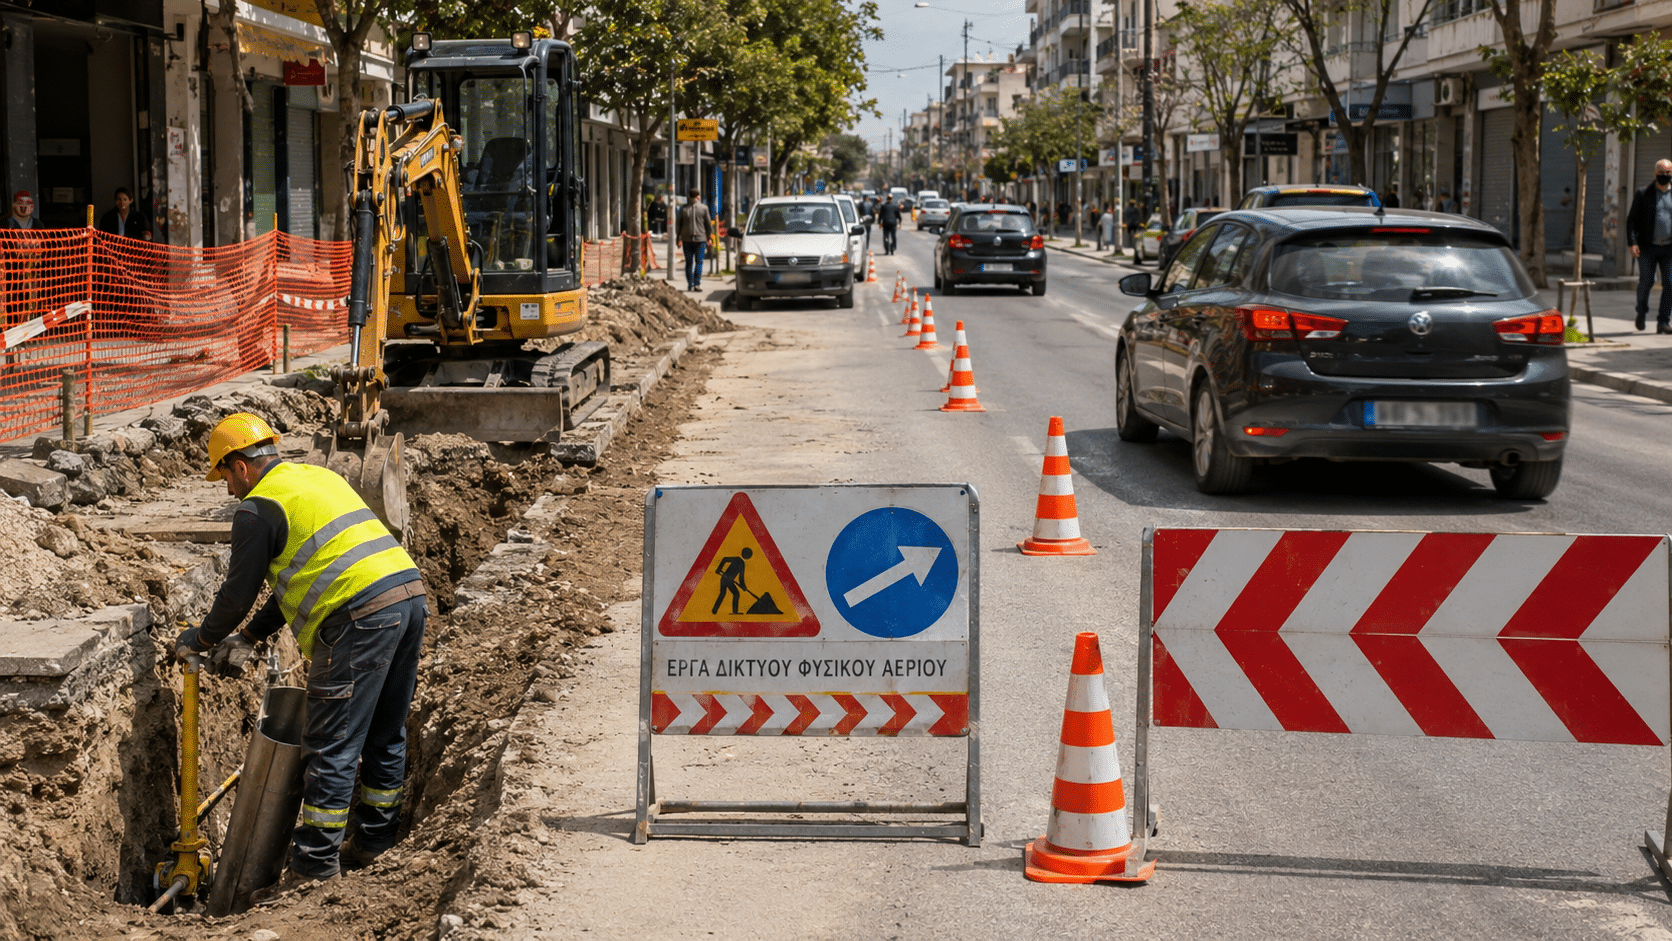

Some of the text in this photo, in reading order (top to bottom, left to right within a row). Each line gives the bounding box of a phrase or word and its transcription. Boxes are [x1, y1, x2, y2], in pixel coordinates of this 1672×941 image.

[667, 659, 947, 677] ΕΡΓΑ ΔΙΚΤΥΟΥ ΦΥΣΙΚΟΥ ΑΕΡΙΟΥ
